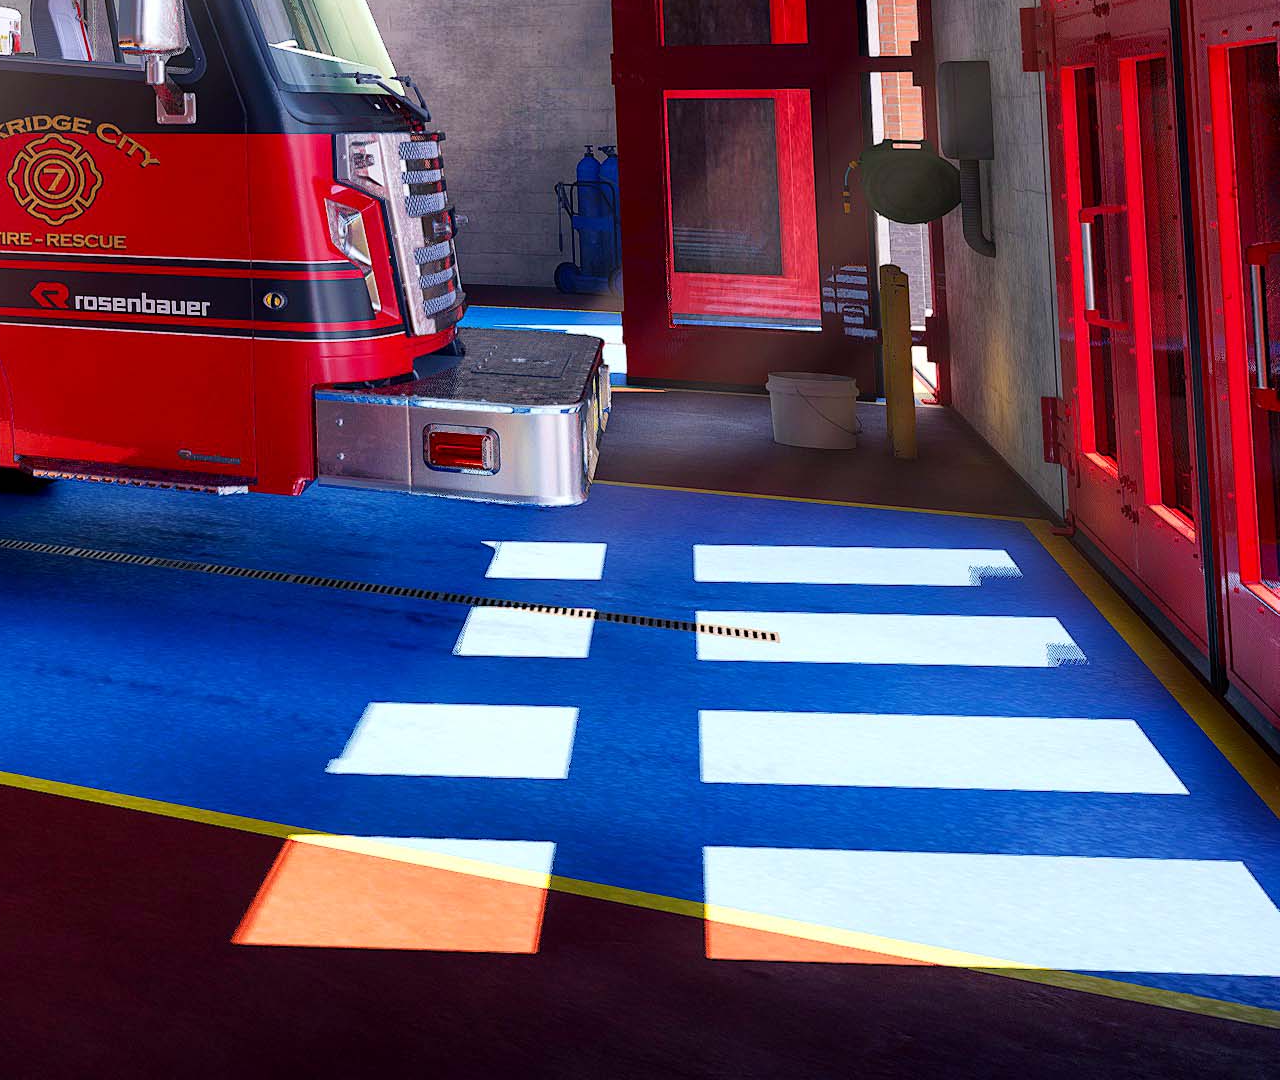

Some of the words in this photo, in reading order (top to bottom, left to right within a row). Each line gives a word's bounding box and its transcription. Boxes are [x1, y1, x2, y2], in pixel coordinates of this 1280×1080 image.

[95, 122, 161, 168] CITY
[42, 167, 66, 192] 7
[74, 292, 211, 317] rosenbauer
